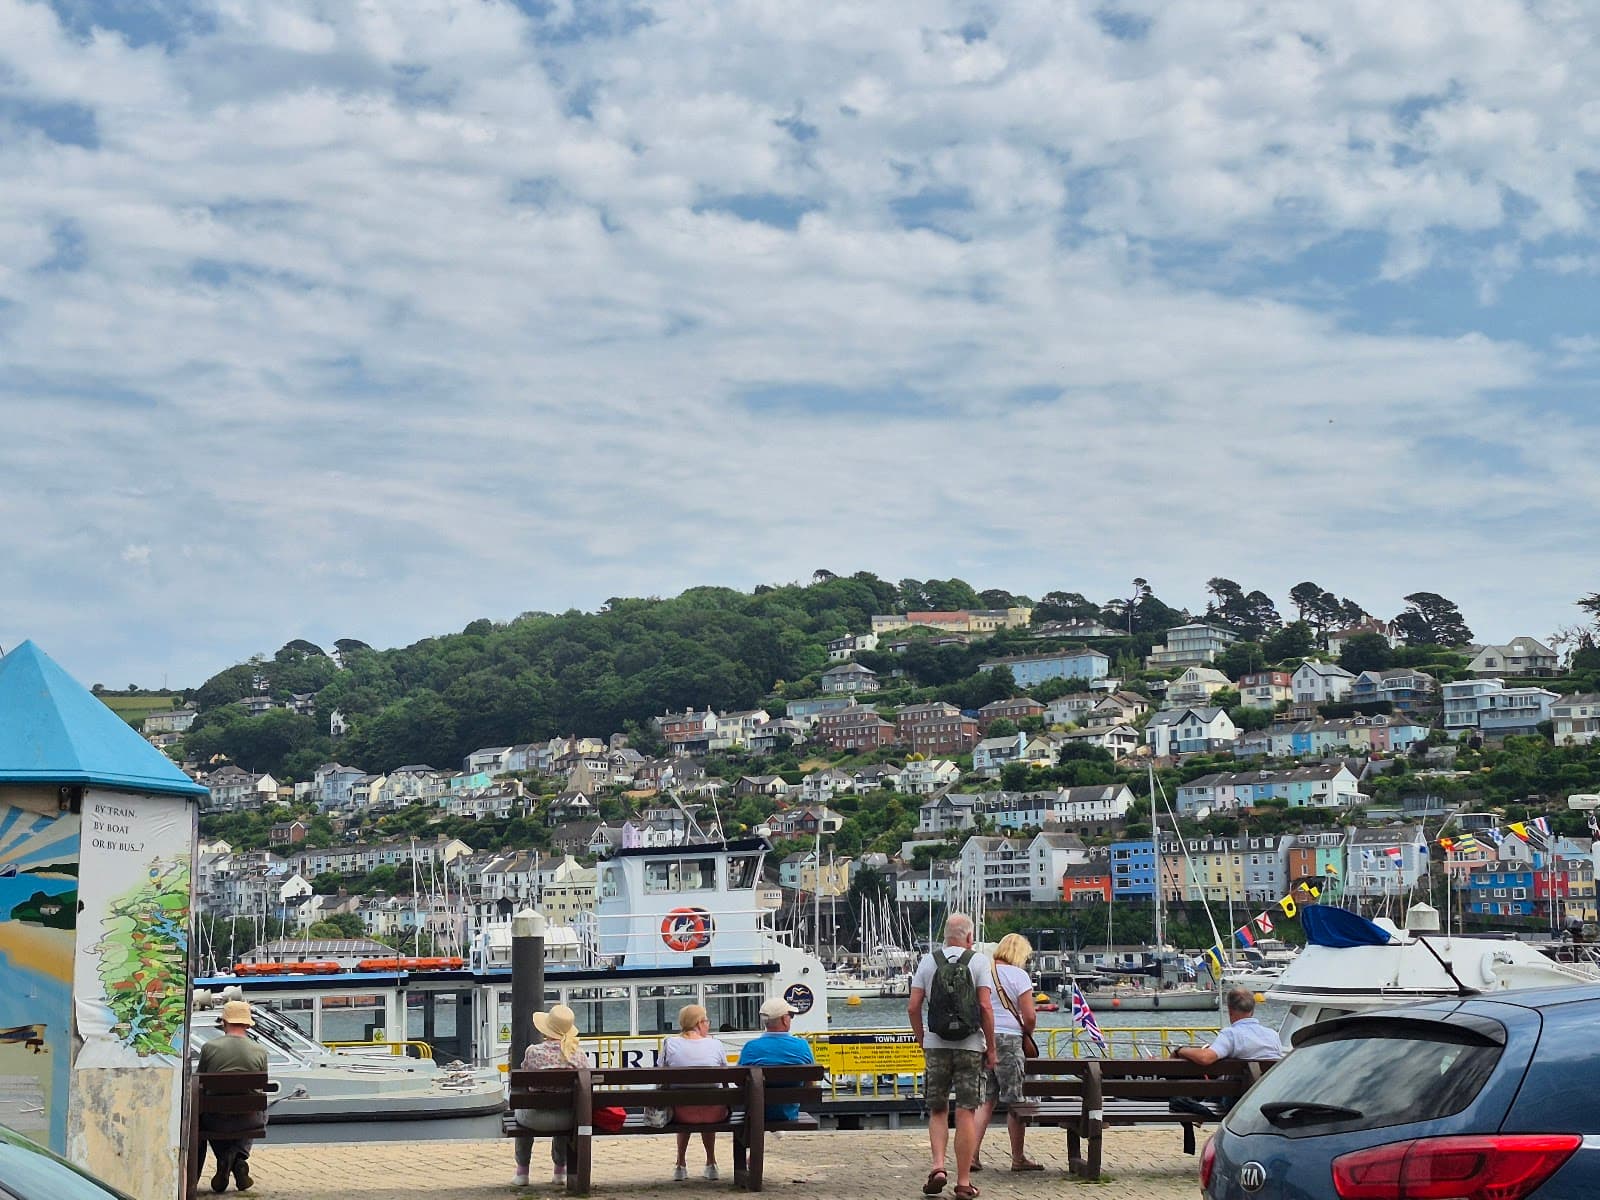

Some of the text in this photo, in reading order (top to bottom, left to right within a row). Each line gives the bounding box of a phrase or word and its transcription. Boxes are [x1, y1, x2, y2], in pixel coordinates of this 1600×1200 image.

[95, 804, 105, 814] BY
[94, 821, 129, 835] BY BOAT
[92, 838, 105, 848] OR
[107, 840, 117, 850] BY
[874, 1035, 916, 1043] TOWN JETTY
[1240, 1168, 1259, 1186] KIA
